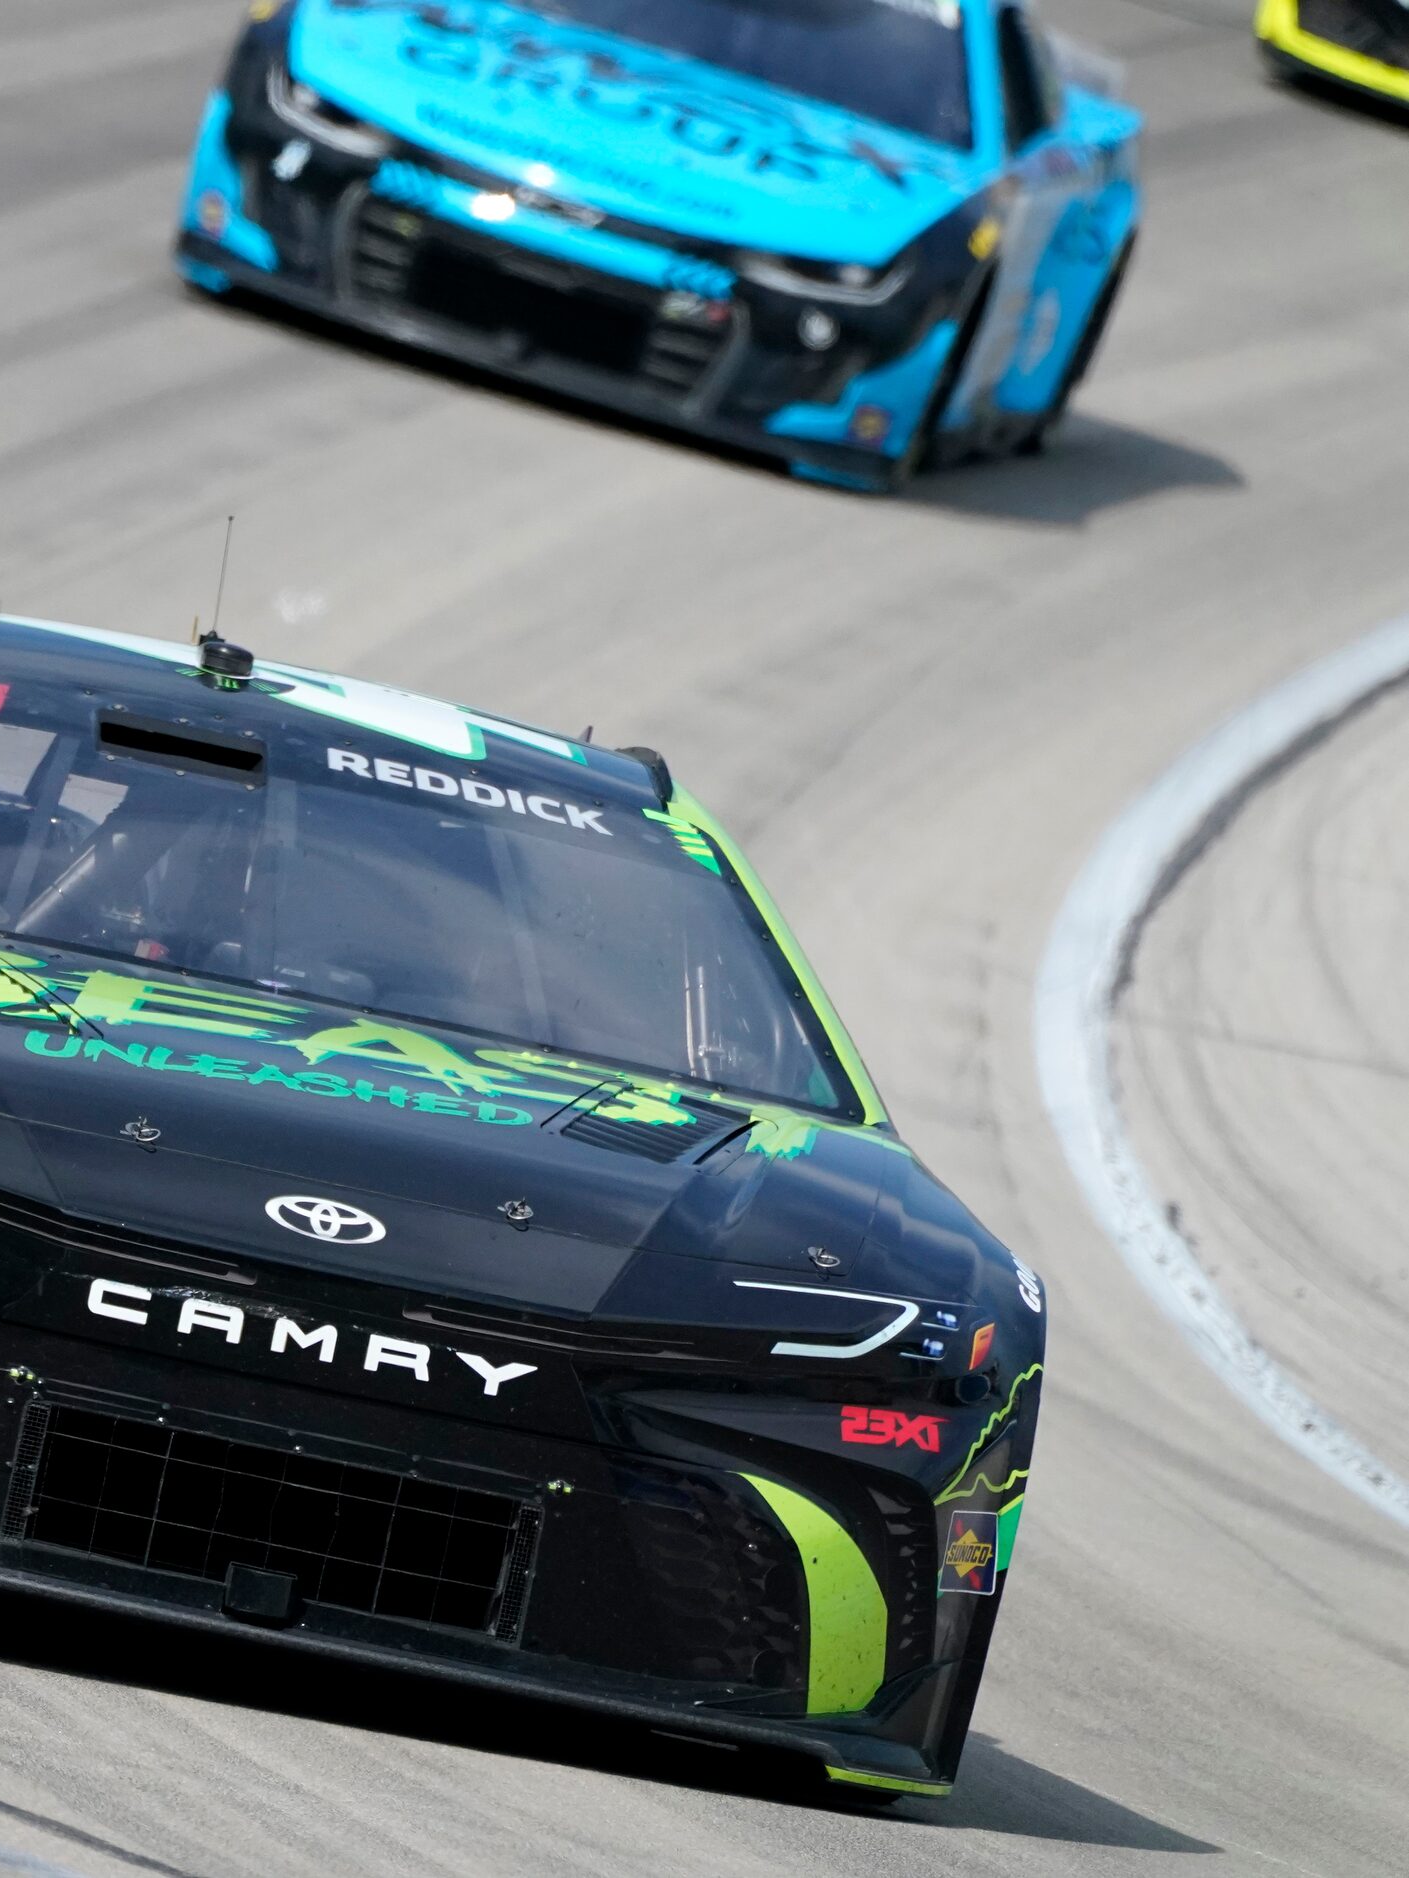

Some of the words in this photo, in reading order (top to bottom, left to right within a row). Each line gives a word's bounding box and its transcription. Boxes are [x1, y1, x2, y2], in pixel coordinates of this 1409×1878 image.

[327, 747, 613, 836] REDDICK
[24, 1029, 534, 1127] UNLEASHED
[87, 1278, 539, 1397] CAMRY
[946, 1544, 990, 1565] SUNOCO
